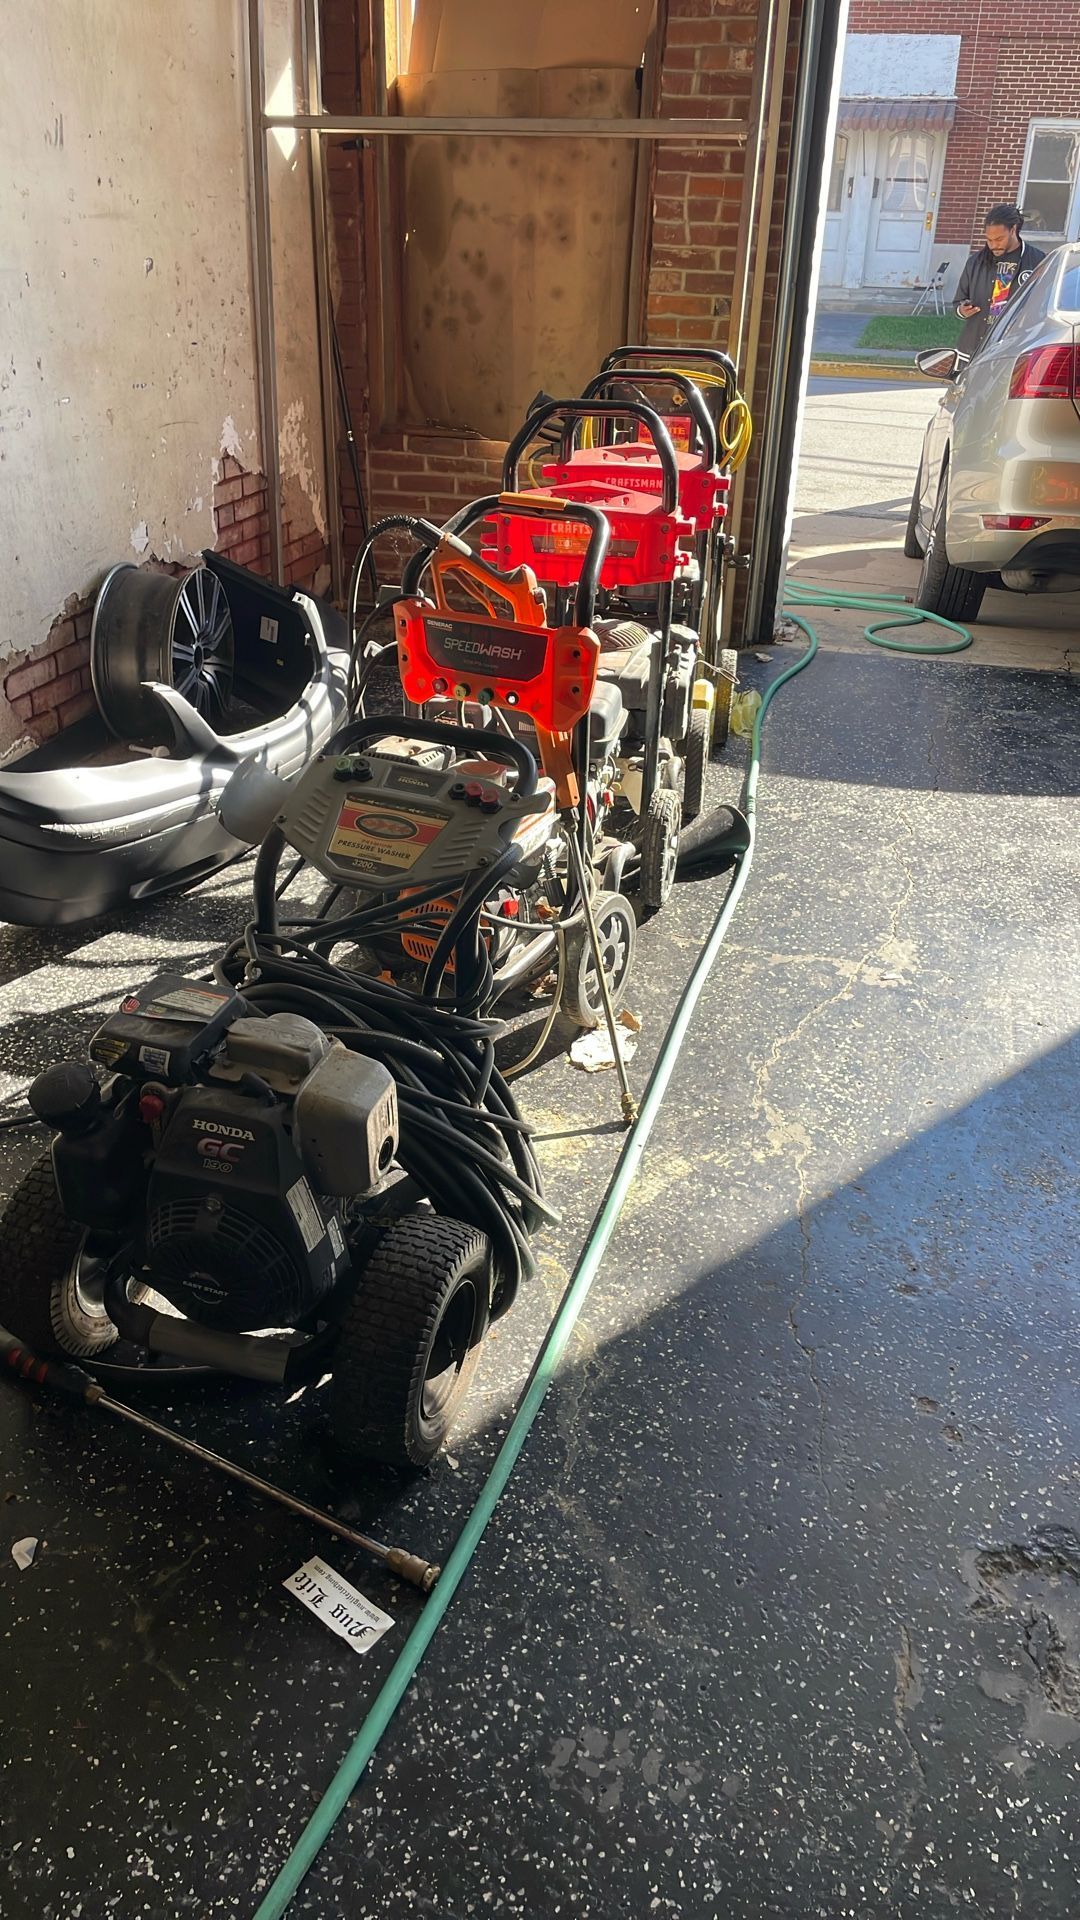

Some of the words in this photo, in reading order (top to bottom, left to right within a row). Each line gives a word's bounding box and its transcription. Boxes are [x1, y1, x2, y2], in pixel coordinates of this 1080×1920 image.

[605, 477, 663, 489] CRAFTSMAN
[443, 637, 523, 661] SPEEDWASH
[337, 839, 375, 852] PRESSURE
[377, 848, 411, 859] WASHER
[352, 859, 374, 869] 3200
[192, 1119, 256, 1142] HONDA
[197, 1137, 245, 1162] GC
[203, 1158, 233, 1173] 190
[294, 1572, 329, 1609] Life
[329, 1603, 377, 1638] Nug
